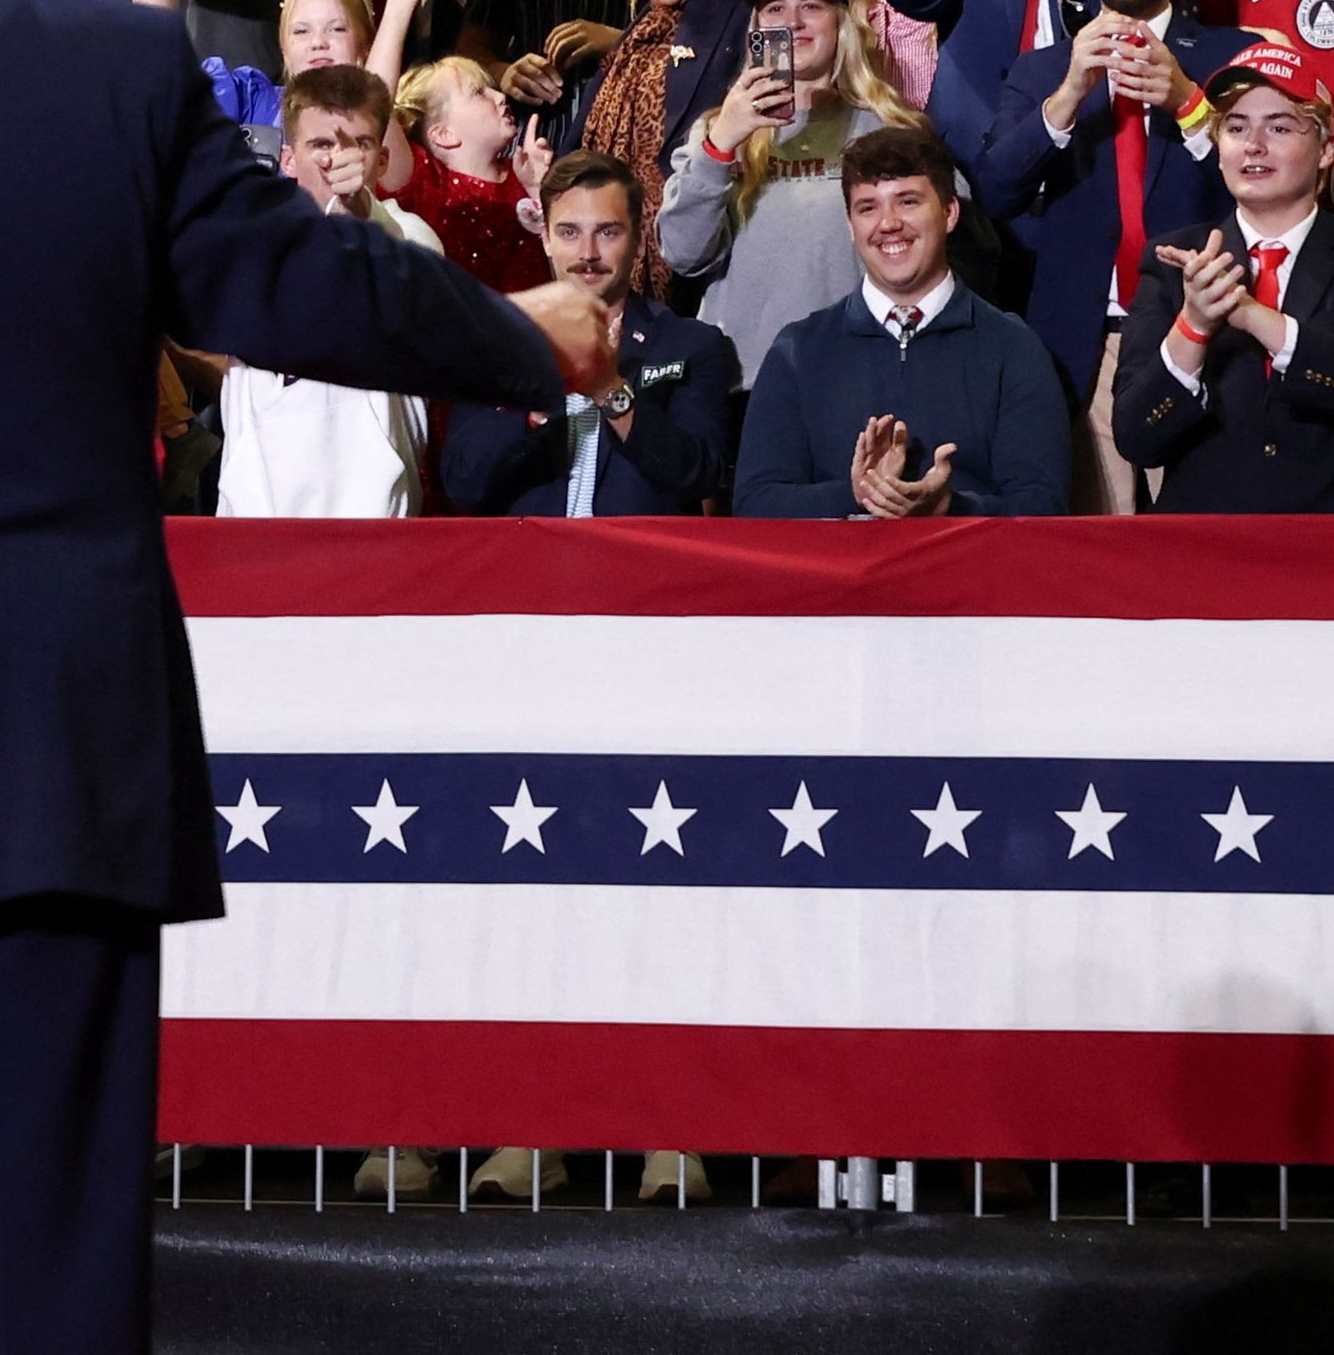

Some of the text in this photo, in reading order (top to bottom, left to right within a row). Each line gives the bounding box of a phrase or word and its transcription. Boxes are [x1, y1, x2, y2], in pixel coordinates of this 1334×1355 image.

[1253, 48, 1302, 68] AMERICA
[1259, 62, 1294, 79] AGAIN
[768, 155, 825, 179] STATE
[644, 364, 681, 381] FABER
